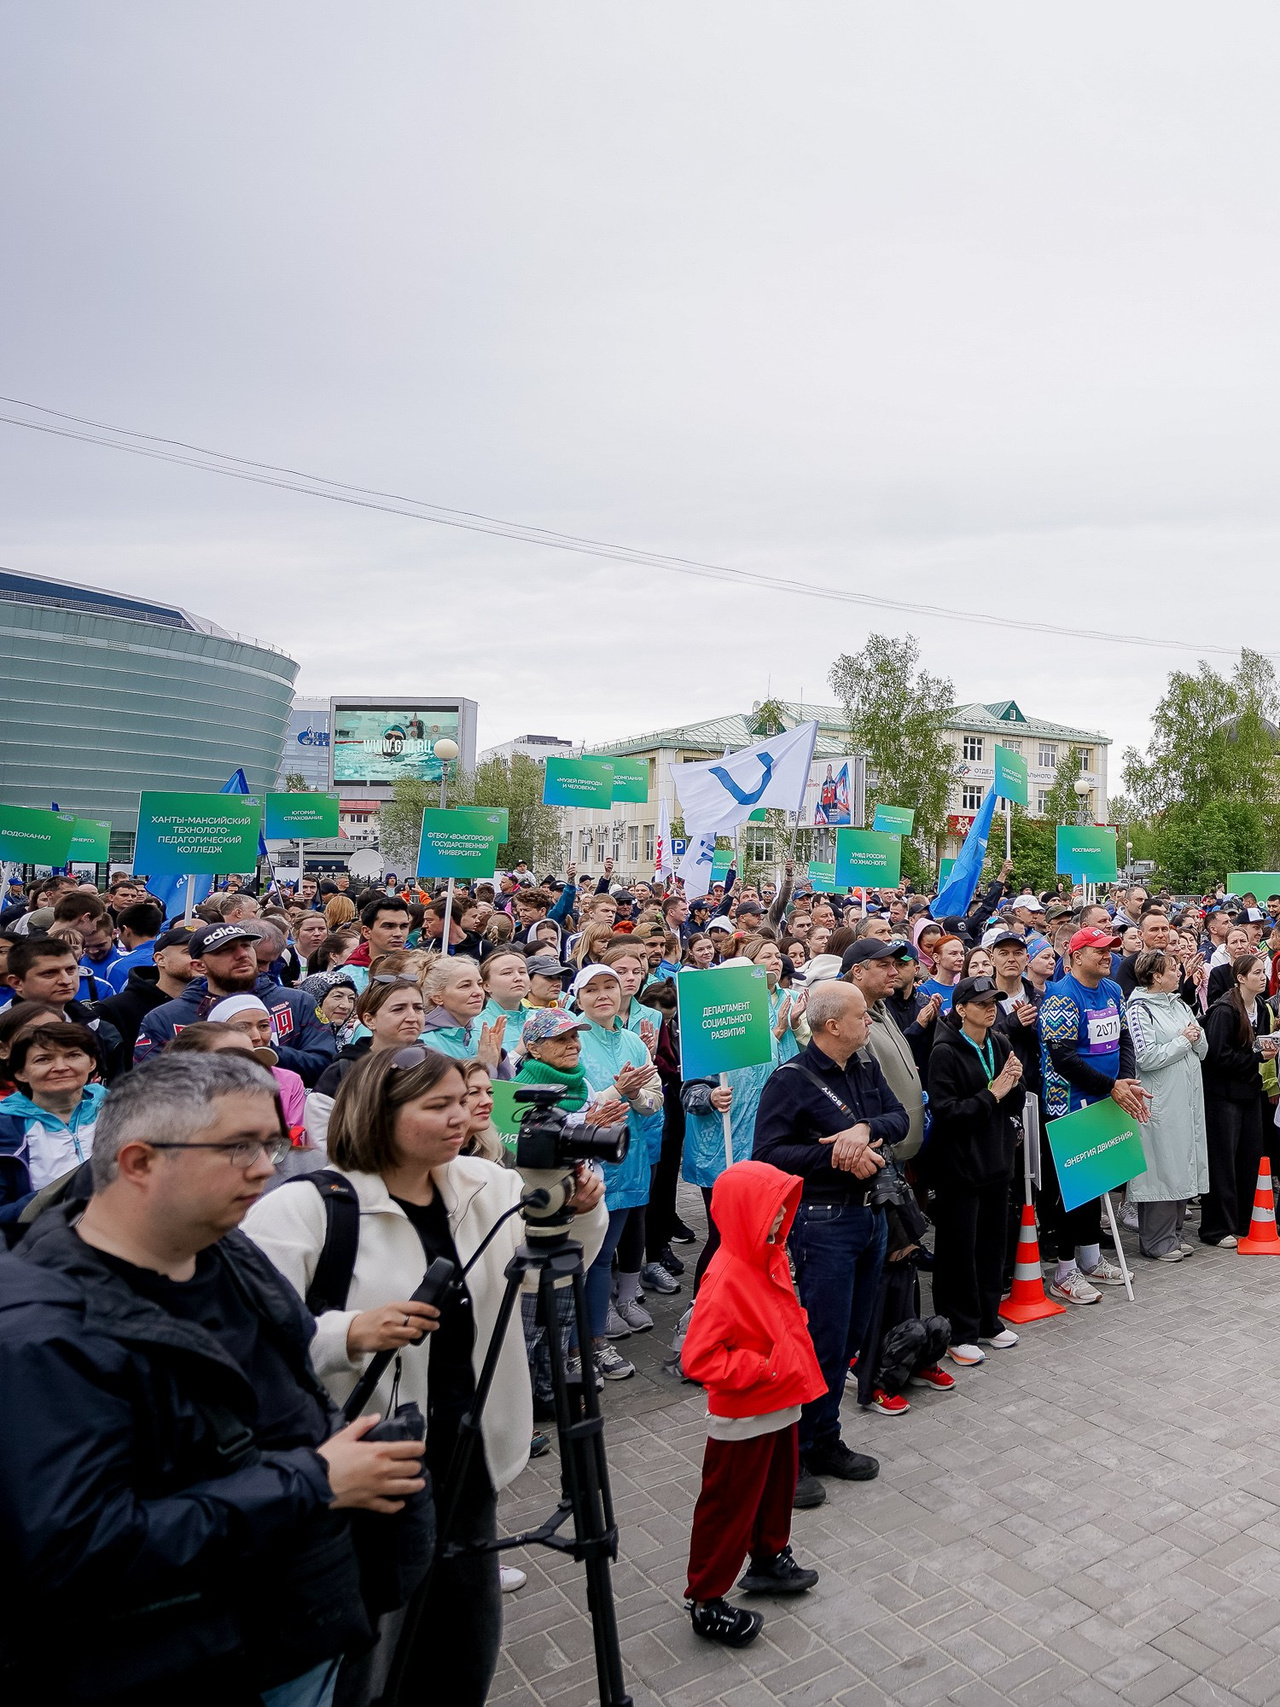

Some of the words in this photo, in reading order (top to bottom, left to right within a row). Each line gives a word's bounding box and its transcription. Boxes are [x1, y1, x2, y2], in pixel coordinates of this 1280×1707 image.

[363, 739, 431, 754] WWW.GTO.RU
[151, 815, 251, 825] ХАНТЫ-МАНСИЙСКИЙ
[1, 829, 52, 841] ВОДОКАНАЛ
[173, 826, 231, 834] ТЕХНОЛОГО-
[157, 835, 242, 844] ПЕДАГОГИЧЕСКИЙ
[431, 840, 489, 849] ГОСУДАРСТВЕННЫЙ
[177, 846, 222, 854] КОЛЛЕДЖ
[203, 925, 247, 946] adida
[702, 1001, 750, 1017] ДЕПАРТАМЕНТ
[701, 1013, 752, 1029] СОЦИАЛЬНОГО
[711, 1026, 746, 1040] РАЗВИТИЯ
[1096, 1021, 1118, 1037] 2071
[821, 1087, 843, 1106] SONY
[1064, 1147, 1097, 1168] «ЭНЕРГИЯ
[1097, 1130, 1134, 1154] ДВИЖЕНИЯ»
